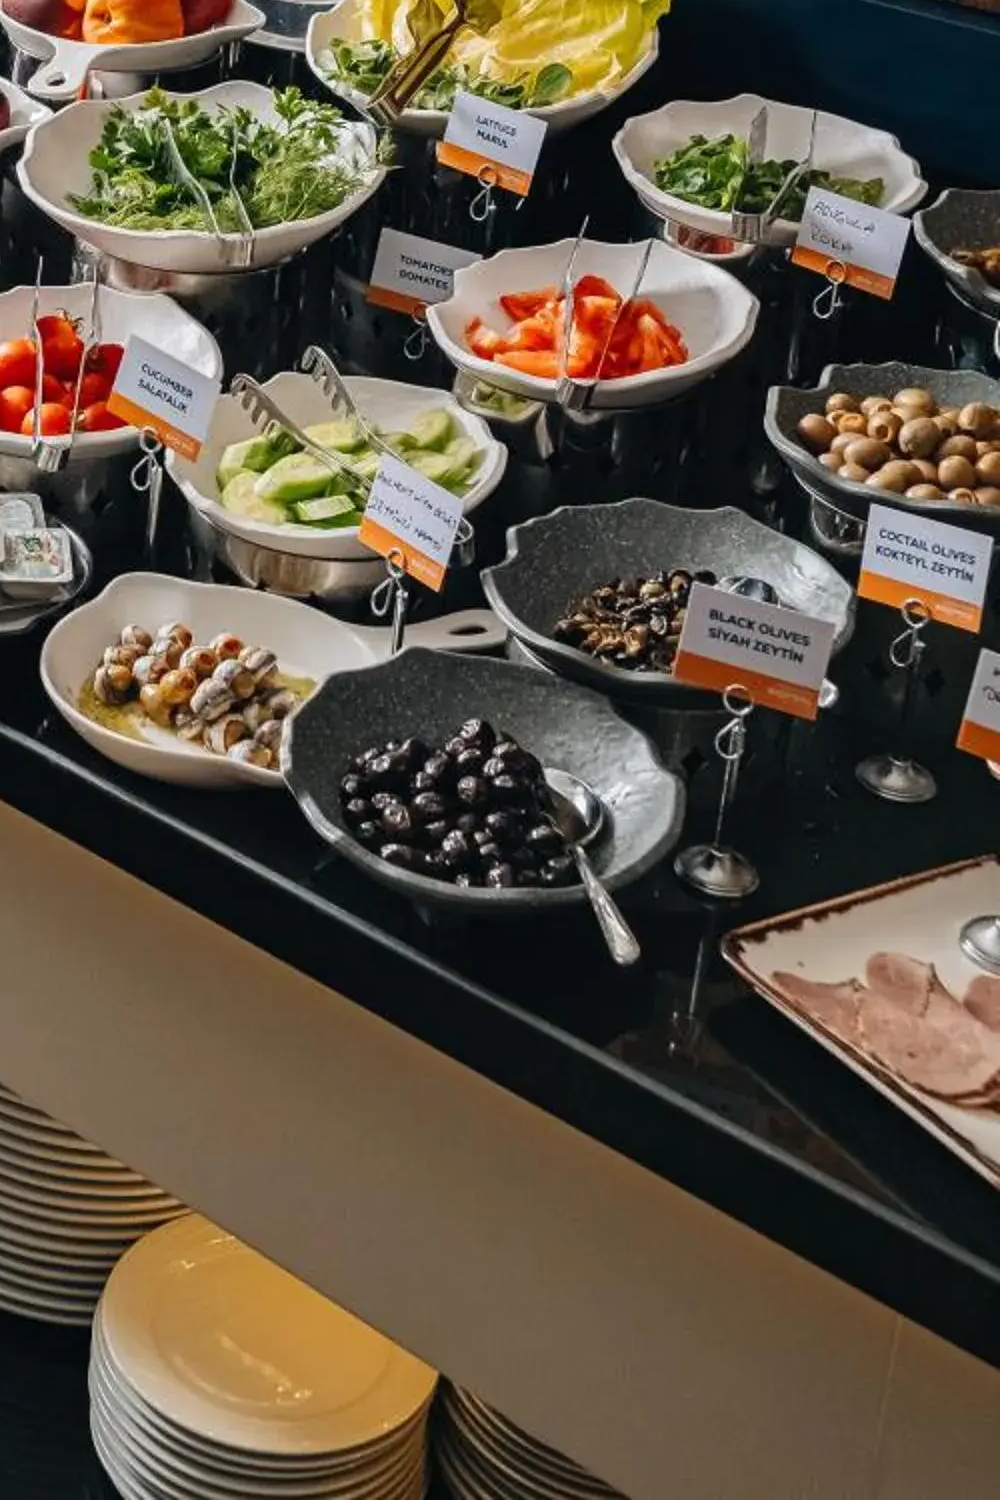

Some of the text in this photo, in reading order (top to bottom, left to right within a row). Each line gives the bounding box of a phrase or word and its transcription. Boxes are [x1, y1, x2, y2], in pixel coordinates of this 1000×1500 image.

[399, 269, 449, 290] DOMATES
[138, 379, 188, 414] SALATALIK
[141, 363, 194, 399] CUCUMBER
[875, 545, 928, 569] KOKTEYL
[879, 528, 976, 565] COCTAIL OLIVES
[709, 608, 811, 647] BLACK OLIVES
